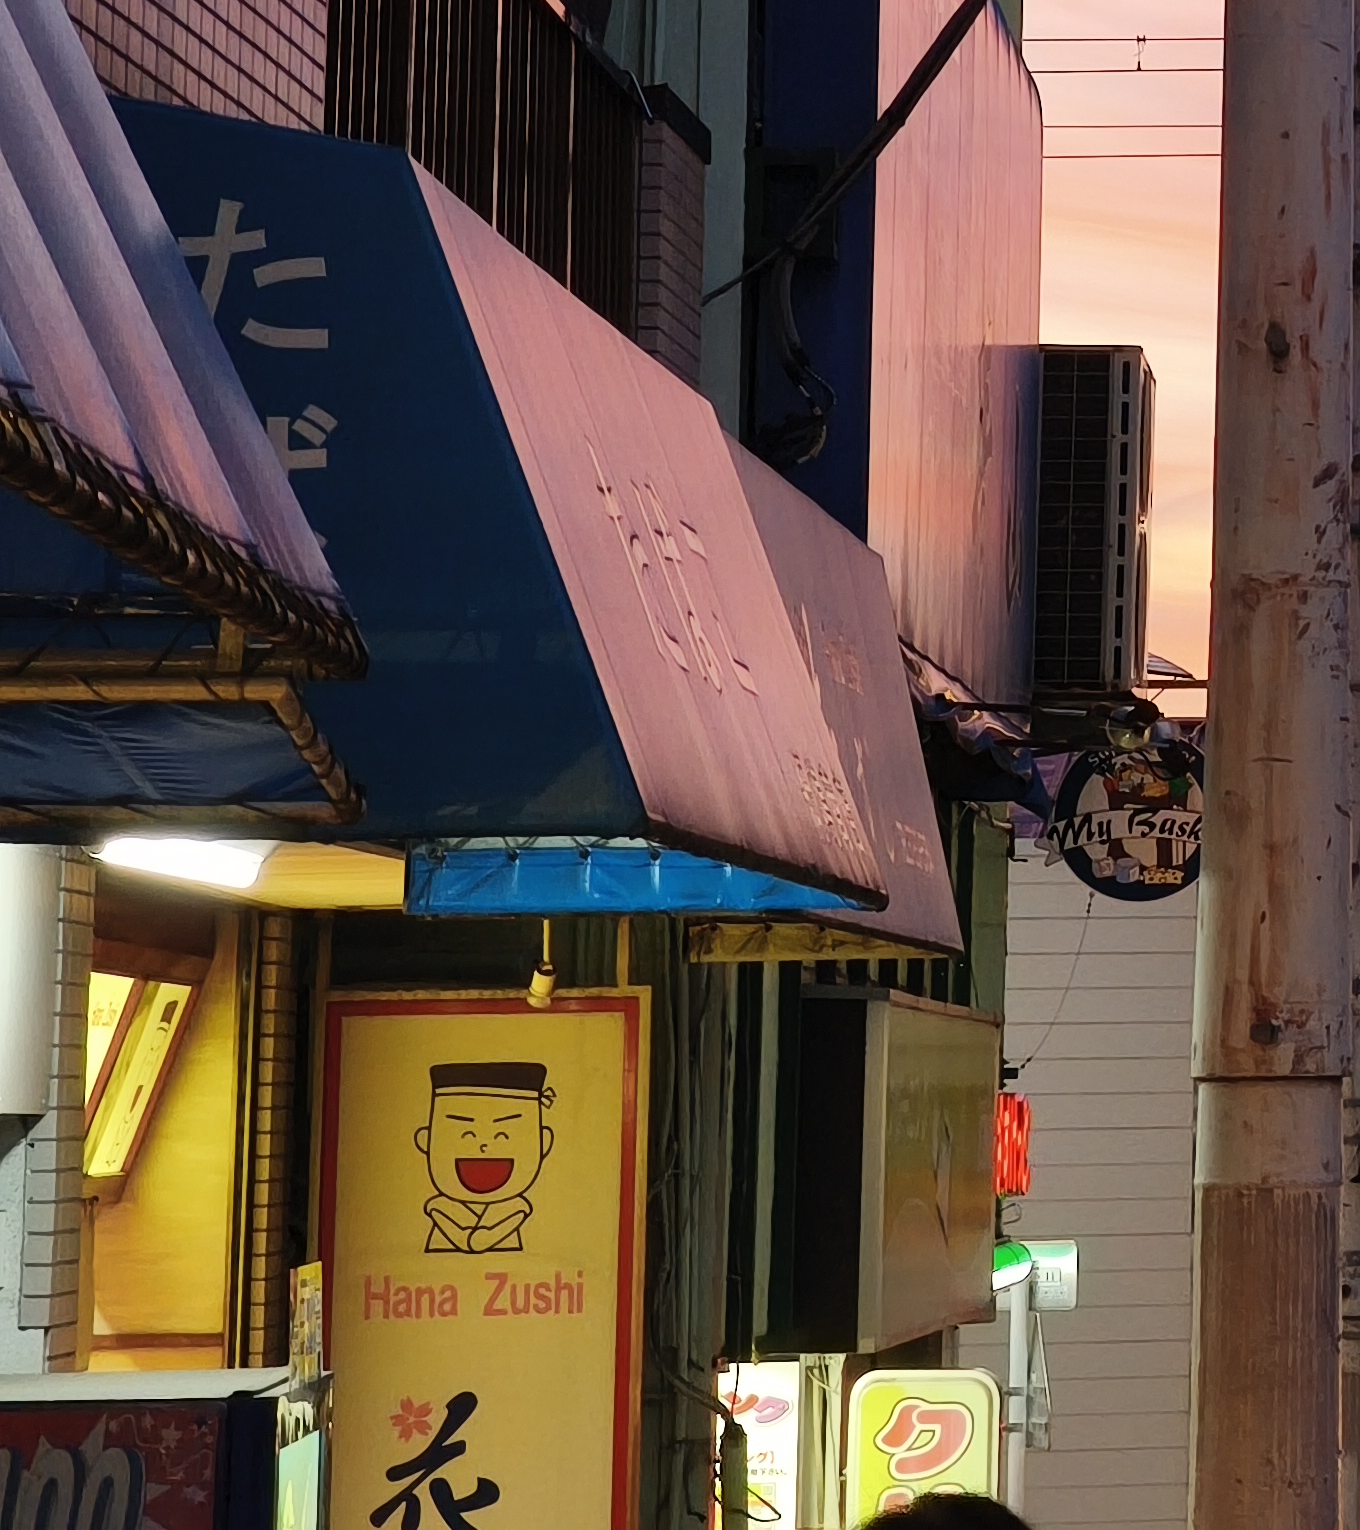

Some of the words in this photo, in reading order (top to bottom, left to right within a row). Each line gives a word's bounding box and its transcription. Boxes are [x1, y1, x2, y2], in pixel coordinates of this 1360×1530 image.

[584, 434, 760, 697] たばこ
[1047, 812, 1113, 852] My
[363, 1274, 459, 1321] Hana
[482, 1271, 585, 1317] Zushi
